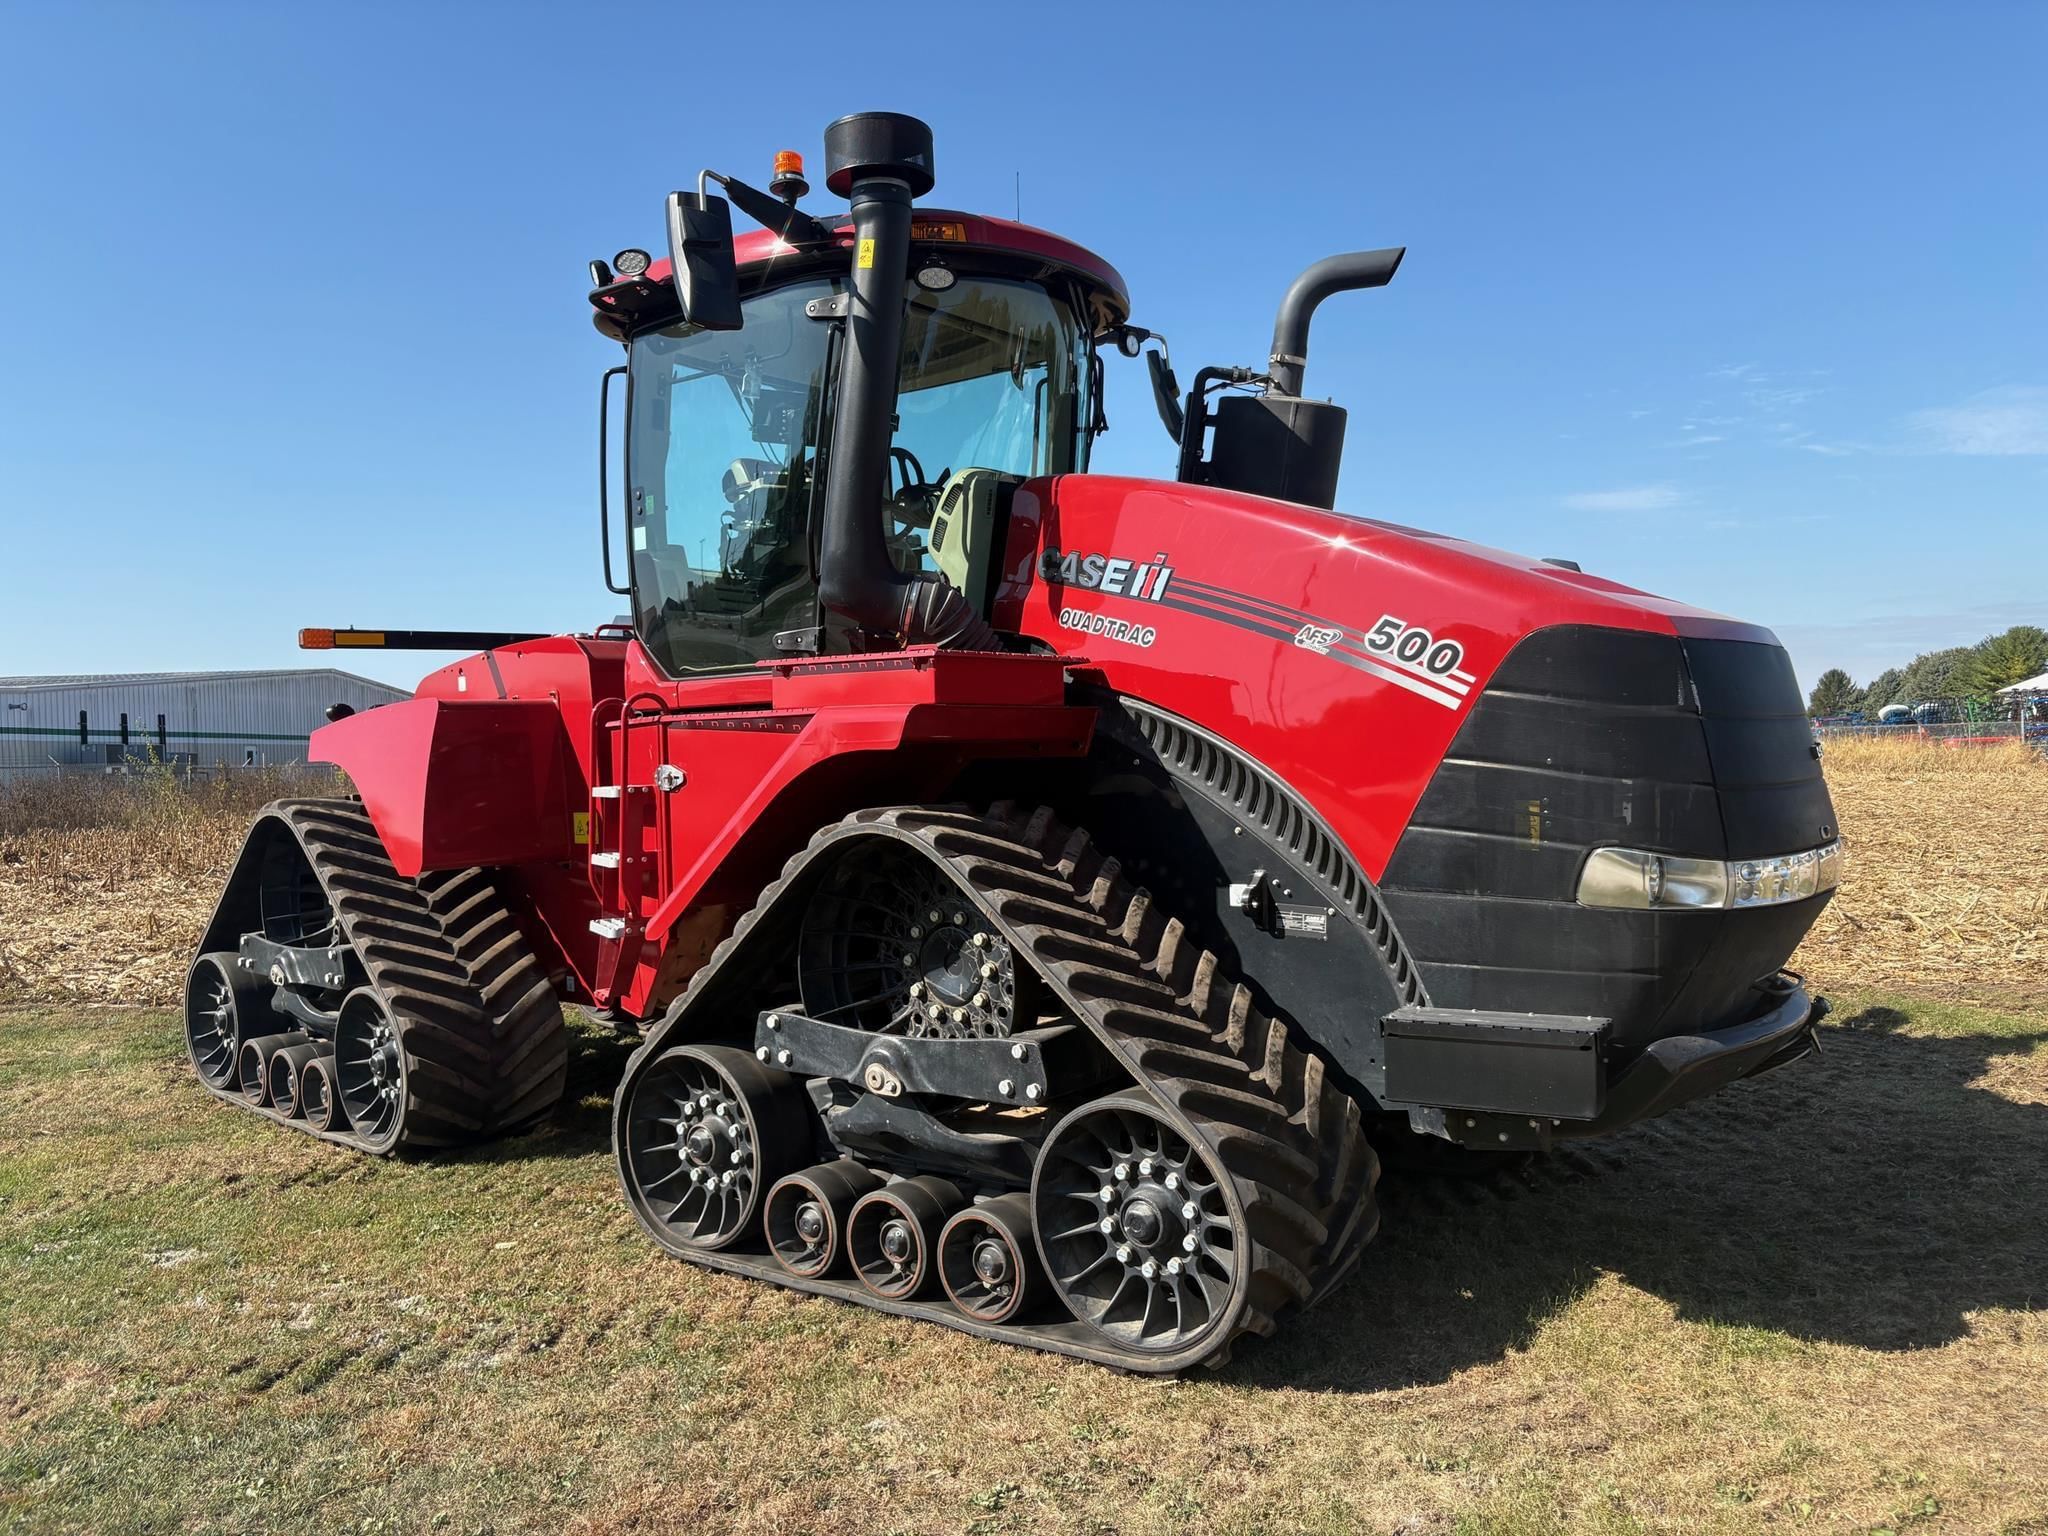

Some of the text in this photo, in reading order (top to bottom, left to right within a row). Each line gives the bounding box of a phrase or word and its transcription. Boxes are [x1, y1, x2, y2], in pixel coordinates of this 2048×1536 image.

[1060, 609, 1155, 646] QUADTRAC
[1297, 626, 1331, 645] AFS
[1366, 617, 1462, 675] 500
